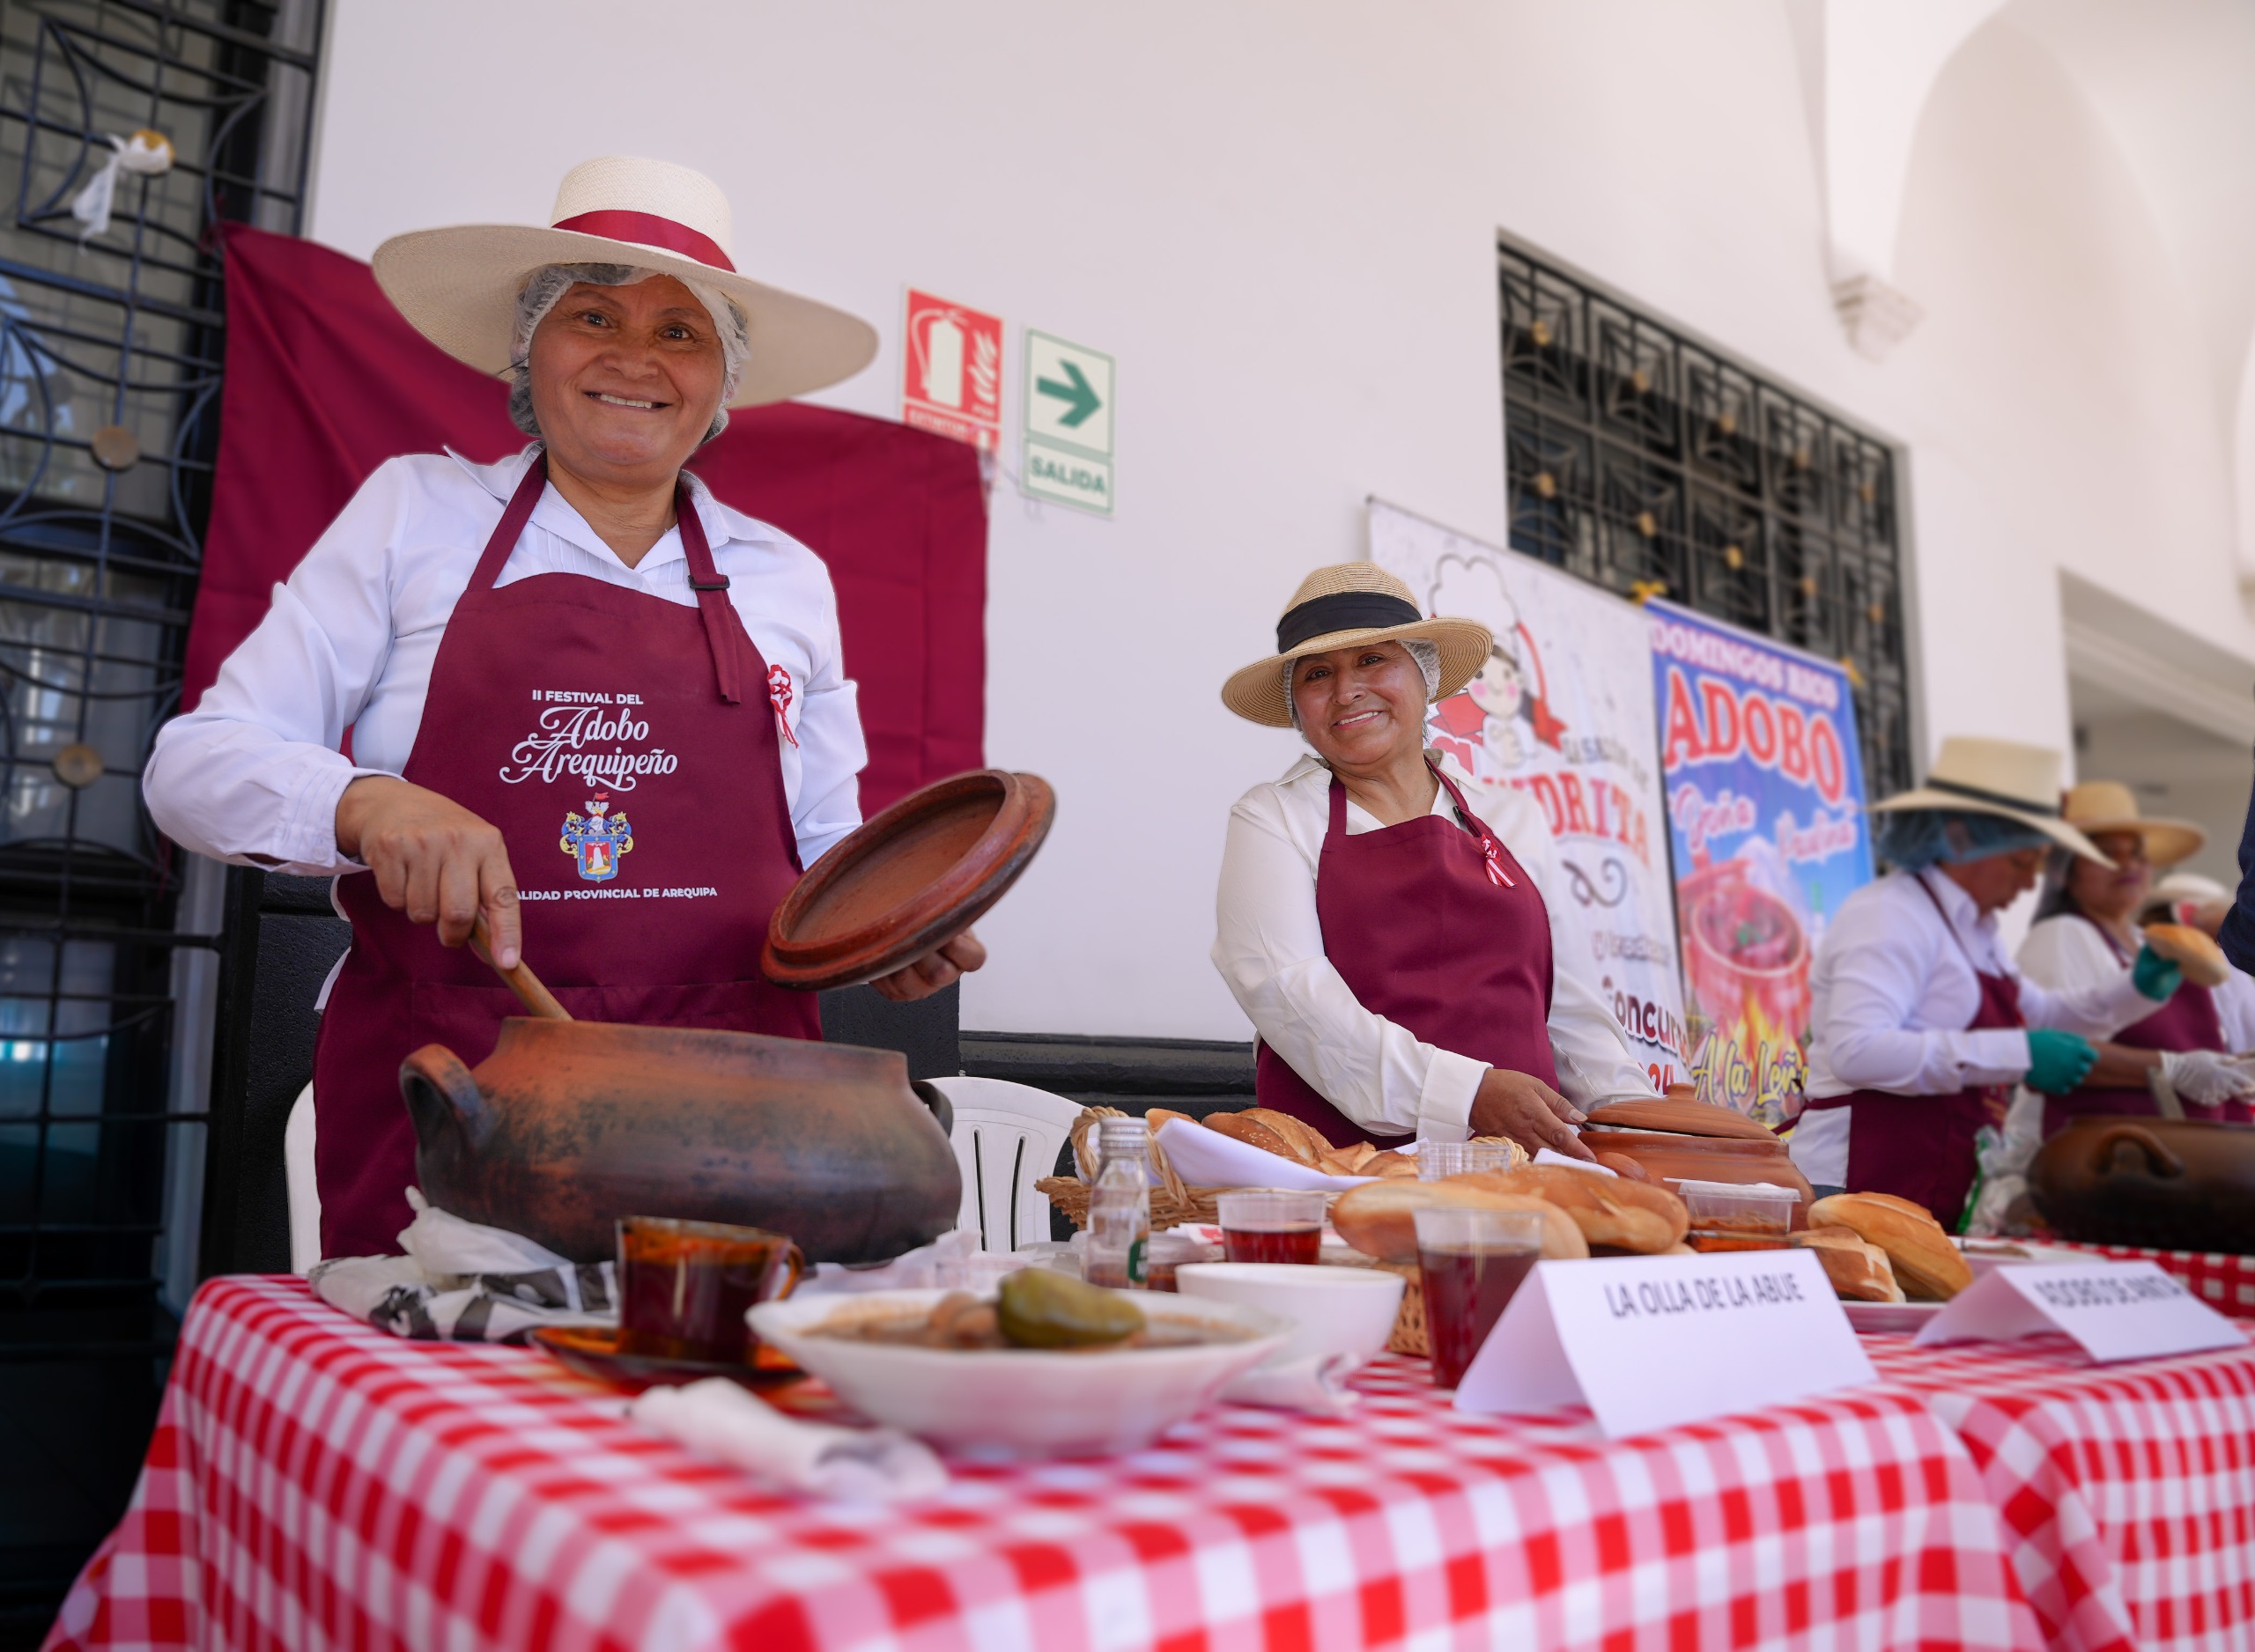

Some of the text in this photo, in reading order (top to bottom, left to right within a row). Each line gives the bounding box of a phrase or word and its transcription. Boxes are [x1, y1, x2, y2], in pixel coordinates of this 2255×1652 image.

[1029, 454, 1107, 494] SALIDA
[532, 690, 644, 704] II FESTIVAL DEL
[528, 705, 650, 749] Adobo
[1662, 667, 1848, 806] ADOBO
[499, 740, 678, 792] Arequipeño
[564, 889, 641, 900] PROVINCIAL
[643, 888, 661, 898] DE
[662, 887, 718, 899] AREQUIPA
[1693, 1030, 1717, 1106] A
[1724, 1040, 1751, 1103] la
[1604, 1282, 1640, 1317] LA
[1638, 1280, 1696, 1314] OLLA
[1693, 1277, 1726, 1309] DE
[1722, 1275, 1755, 1307] LA
